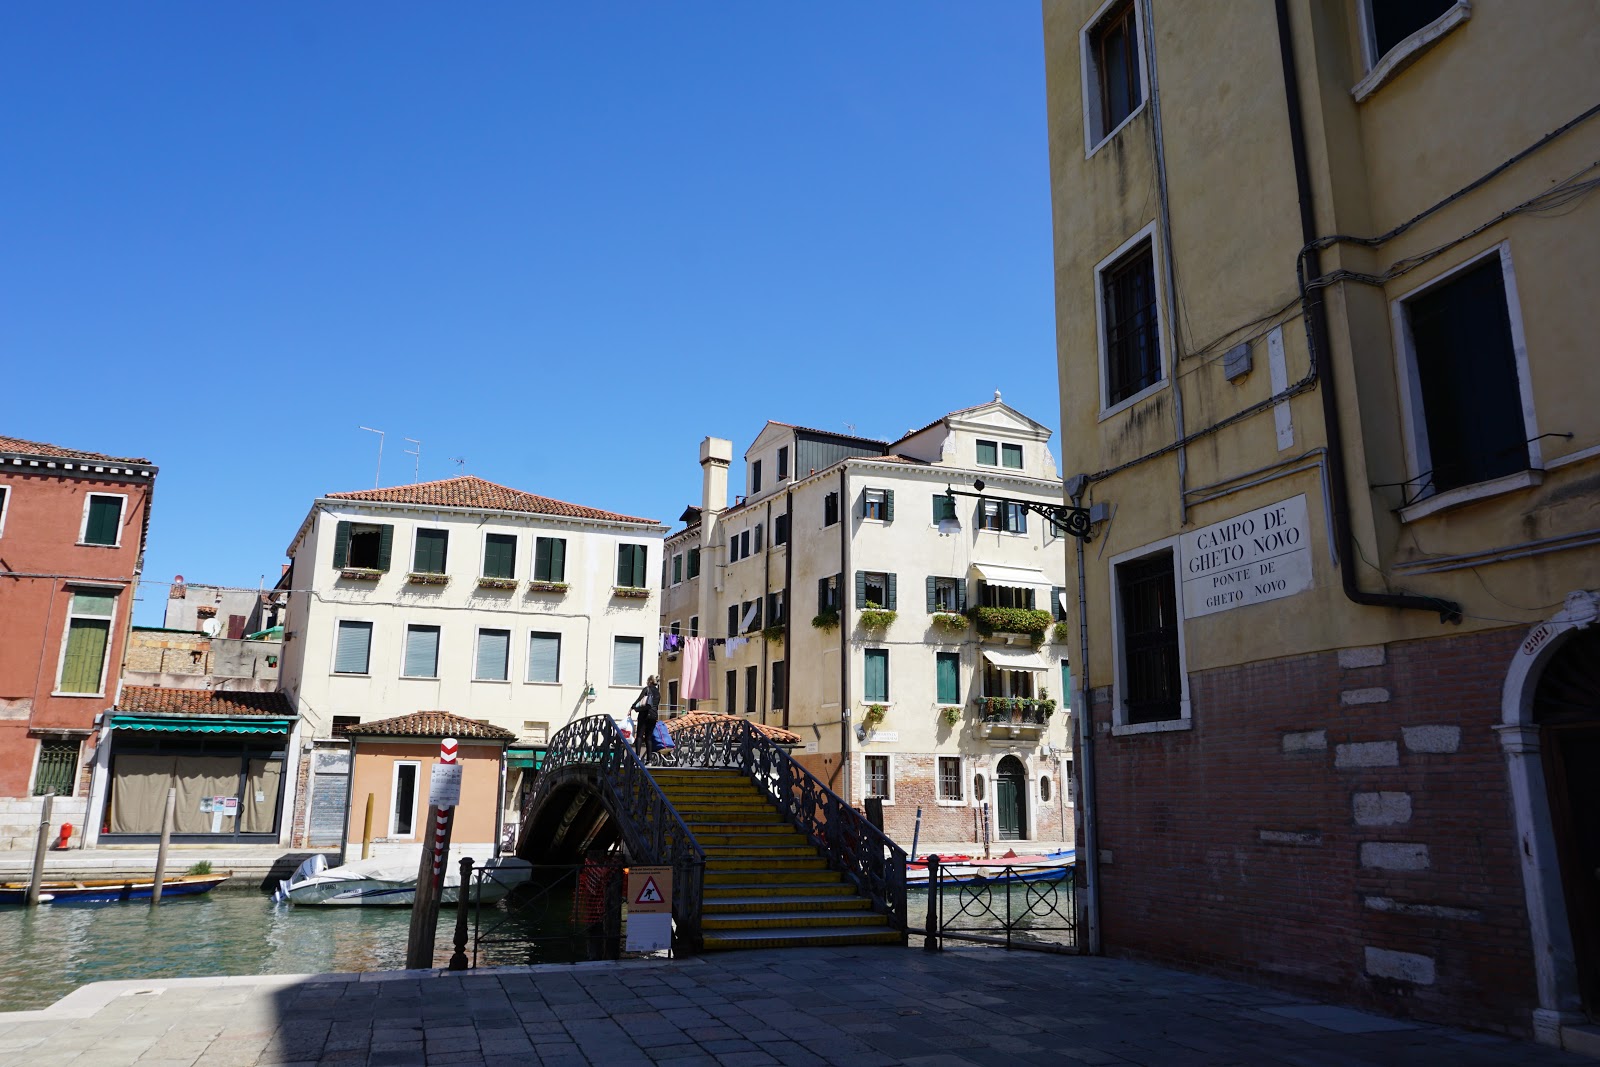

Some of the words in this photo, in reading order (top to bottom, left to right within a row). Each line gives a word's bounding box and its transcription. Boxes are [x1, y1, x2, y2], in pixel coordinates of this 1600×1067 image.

[1197, 519, 1255, 550] CAMPO
[1263, 507, 1287, 530] DE
[1189, 544, 1244, 573] GHETO
[1253, 527, 1300, 556] NOVO
[1213, 568, 1251, 588] PONTE
[1259, 562, 1276, 576] DE
[1206, 590, 1244, 608] GHETO
[1254, 579, 1286, 597] NOVO
[1524, 626, 1549, 653] 2921
